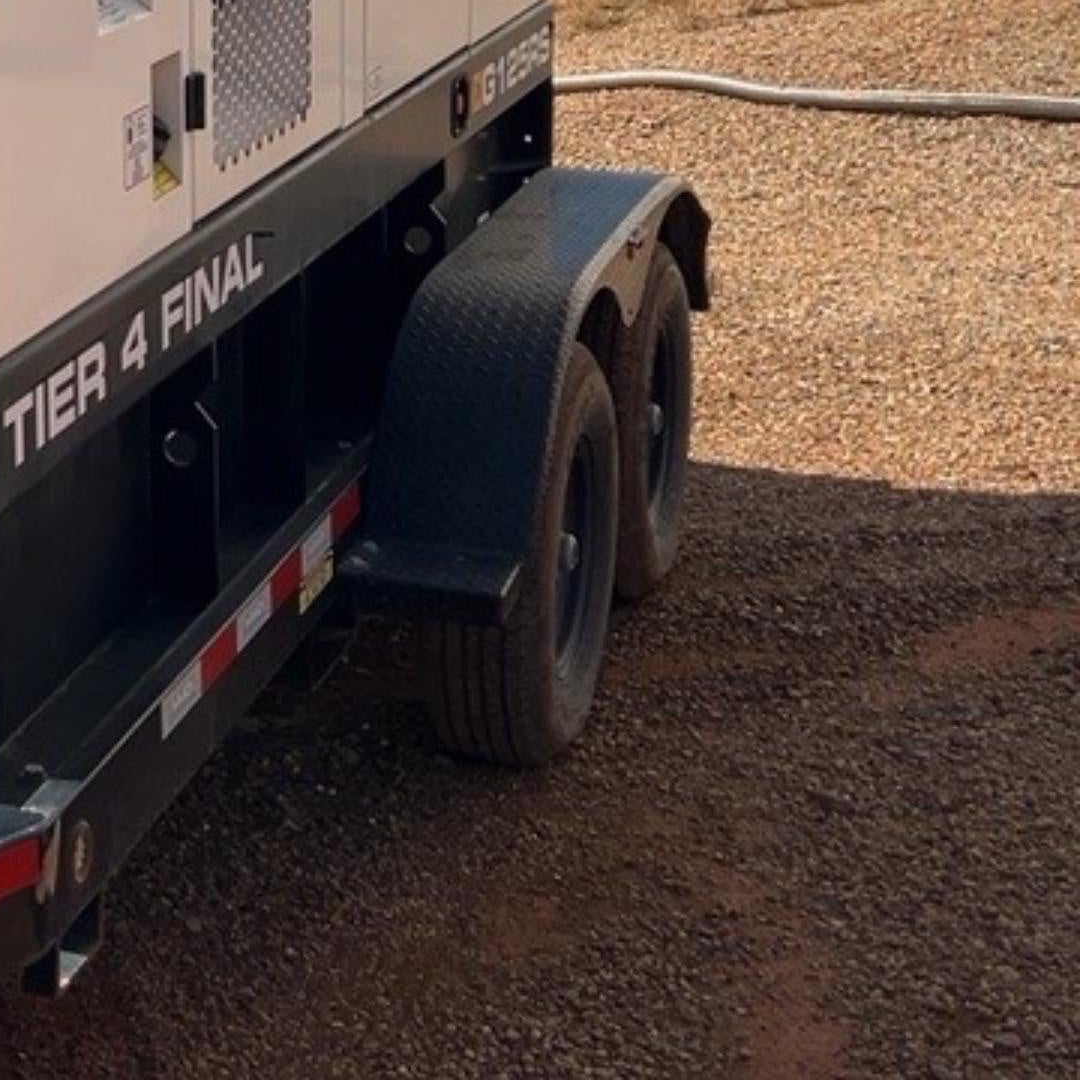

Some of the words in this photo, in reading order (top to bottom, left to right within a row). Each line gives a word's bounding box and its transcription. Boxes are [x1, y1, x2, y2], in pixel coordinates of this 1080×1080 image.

[2, 341, 106, 467] TIER
[122, 310, 148, 371] 4
[161, 233, 265, 352] FINAL
